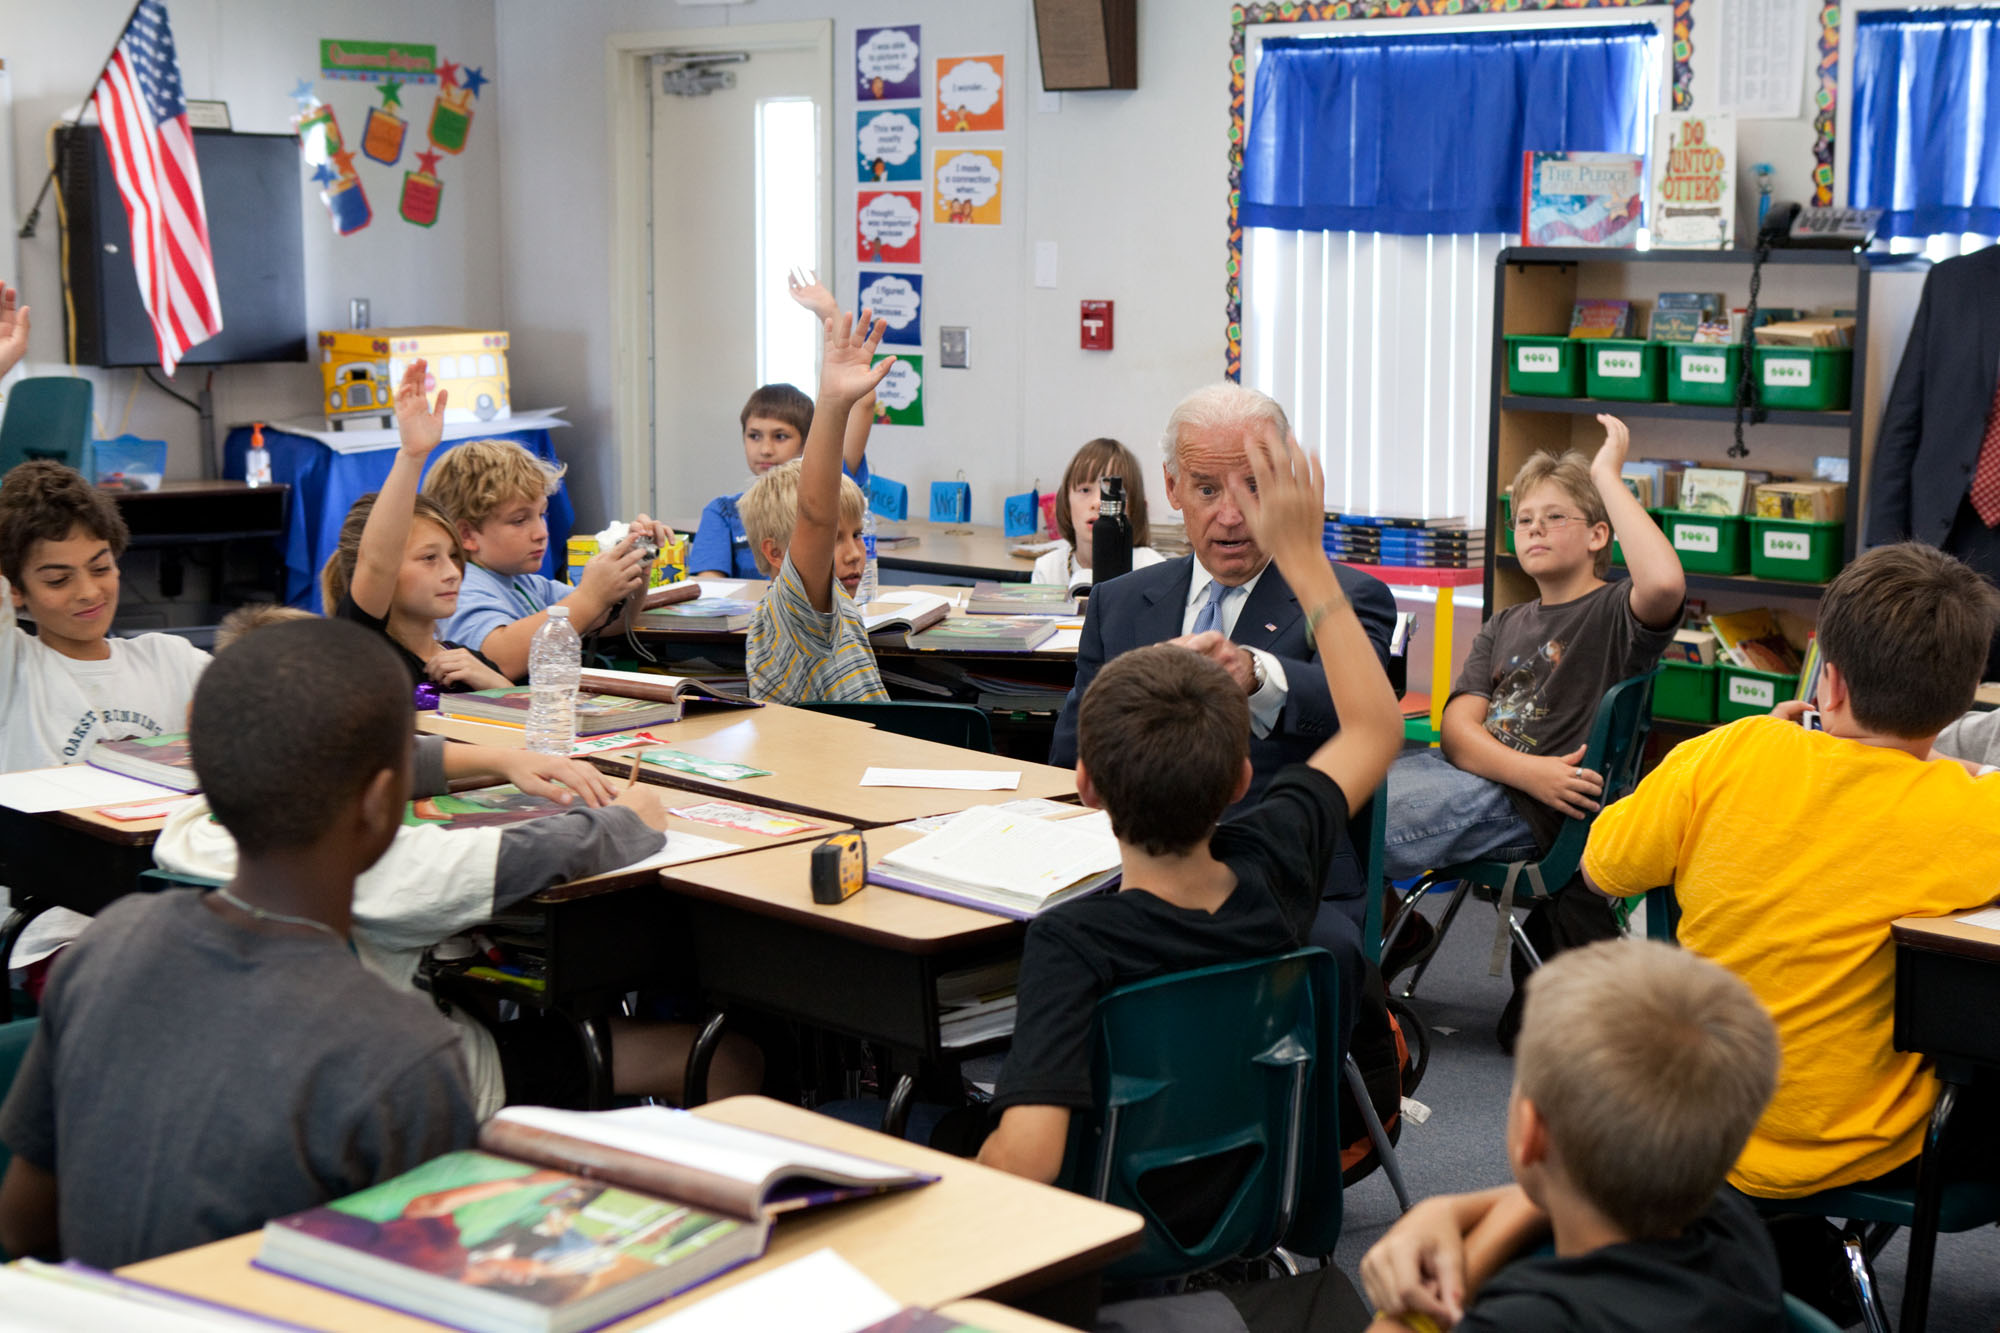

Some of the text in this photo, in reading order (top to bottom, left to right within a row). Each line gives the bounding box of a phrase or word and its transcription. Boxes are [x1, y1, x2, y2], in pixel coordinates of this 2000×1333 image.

[1683, 121, 1704, 146] DO
[1671, 148, 1713, 173] UNTO
[1663, 175, 1720, 203] OTTERS
